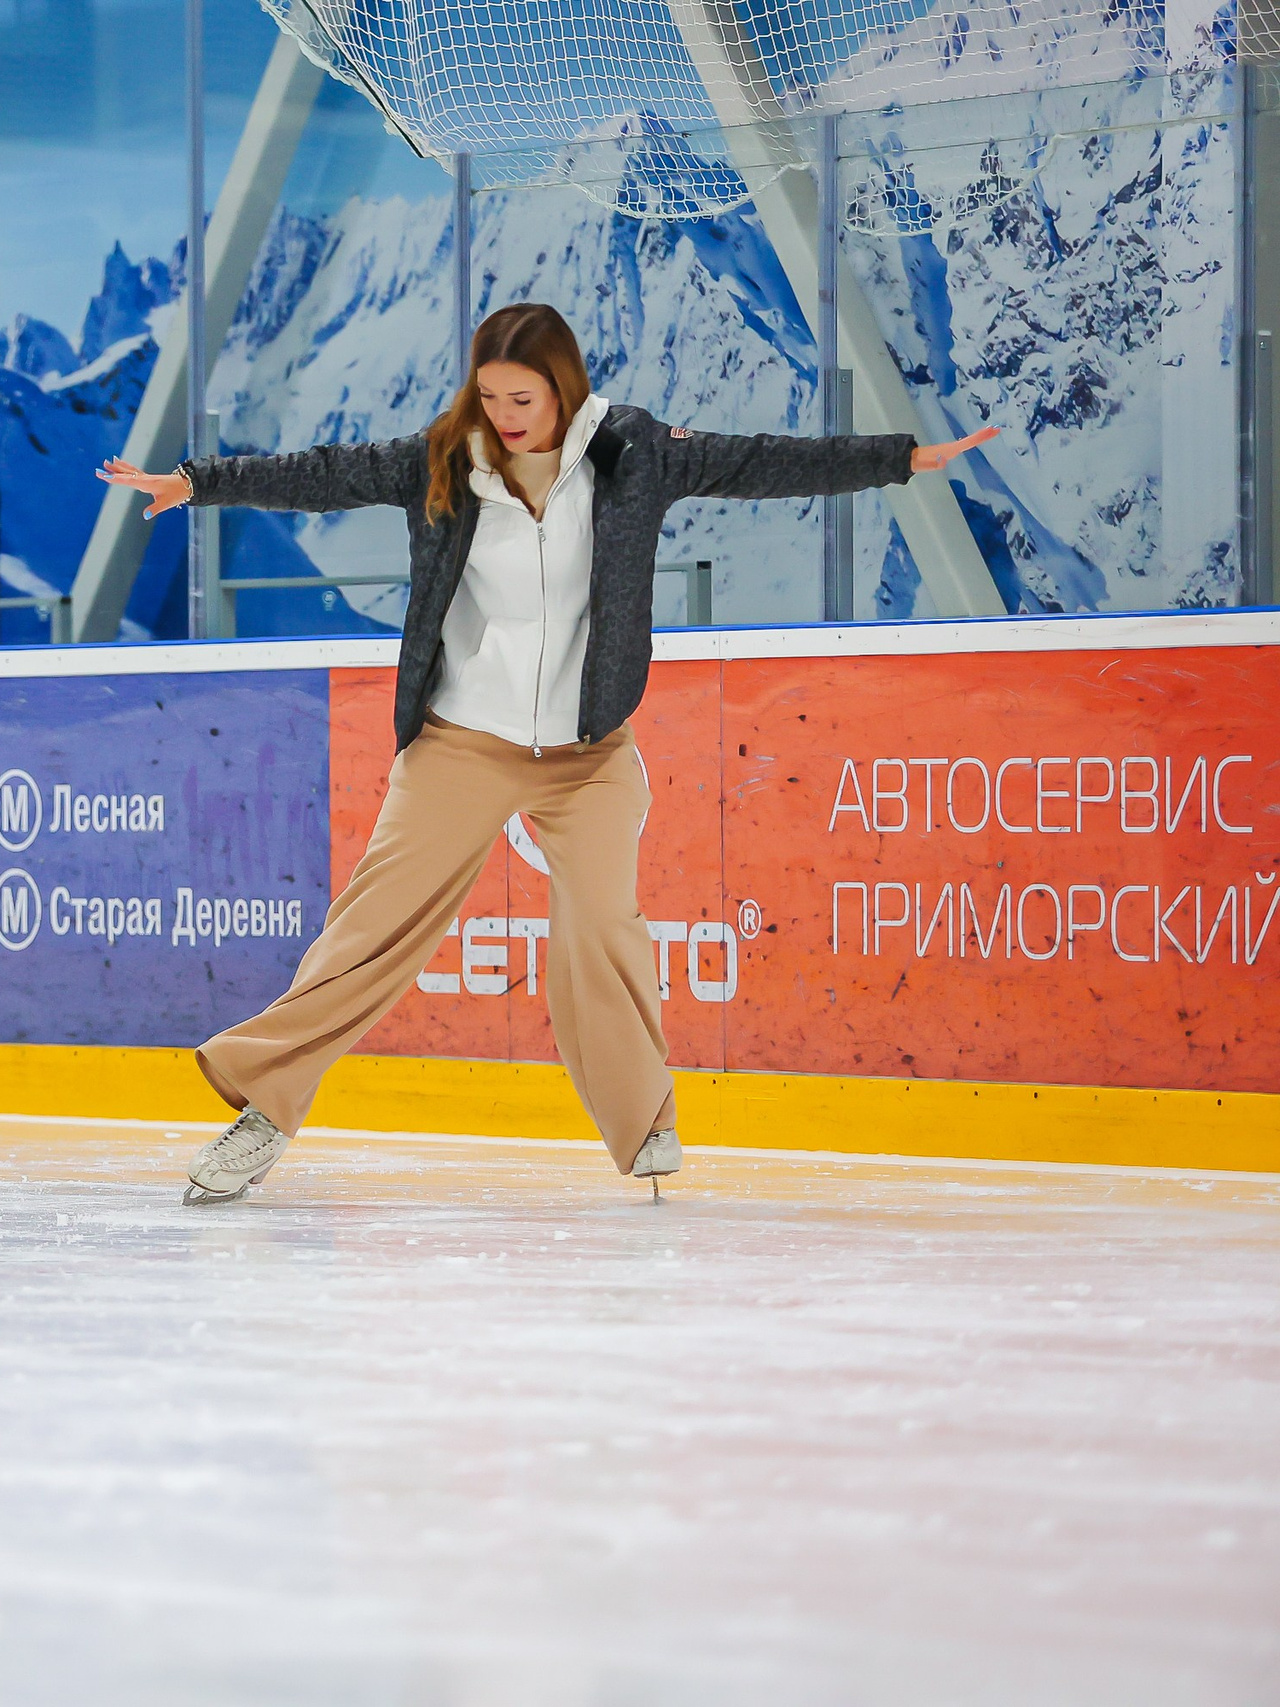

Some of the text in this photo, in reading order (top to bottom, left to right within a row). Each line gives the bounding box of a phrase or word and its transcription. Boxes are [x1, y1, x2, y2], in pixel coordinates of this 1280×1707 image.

[49, 784, 165, 833] Лесная
[828, 756, 1253, 833] АВТОСЕРВИС
[49, 886, 162, 946] Старая
[172, 887, 302, 948] Деревня
[831, 871, 1280, 965] ПРИМОРСКИЙ
